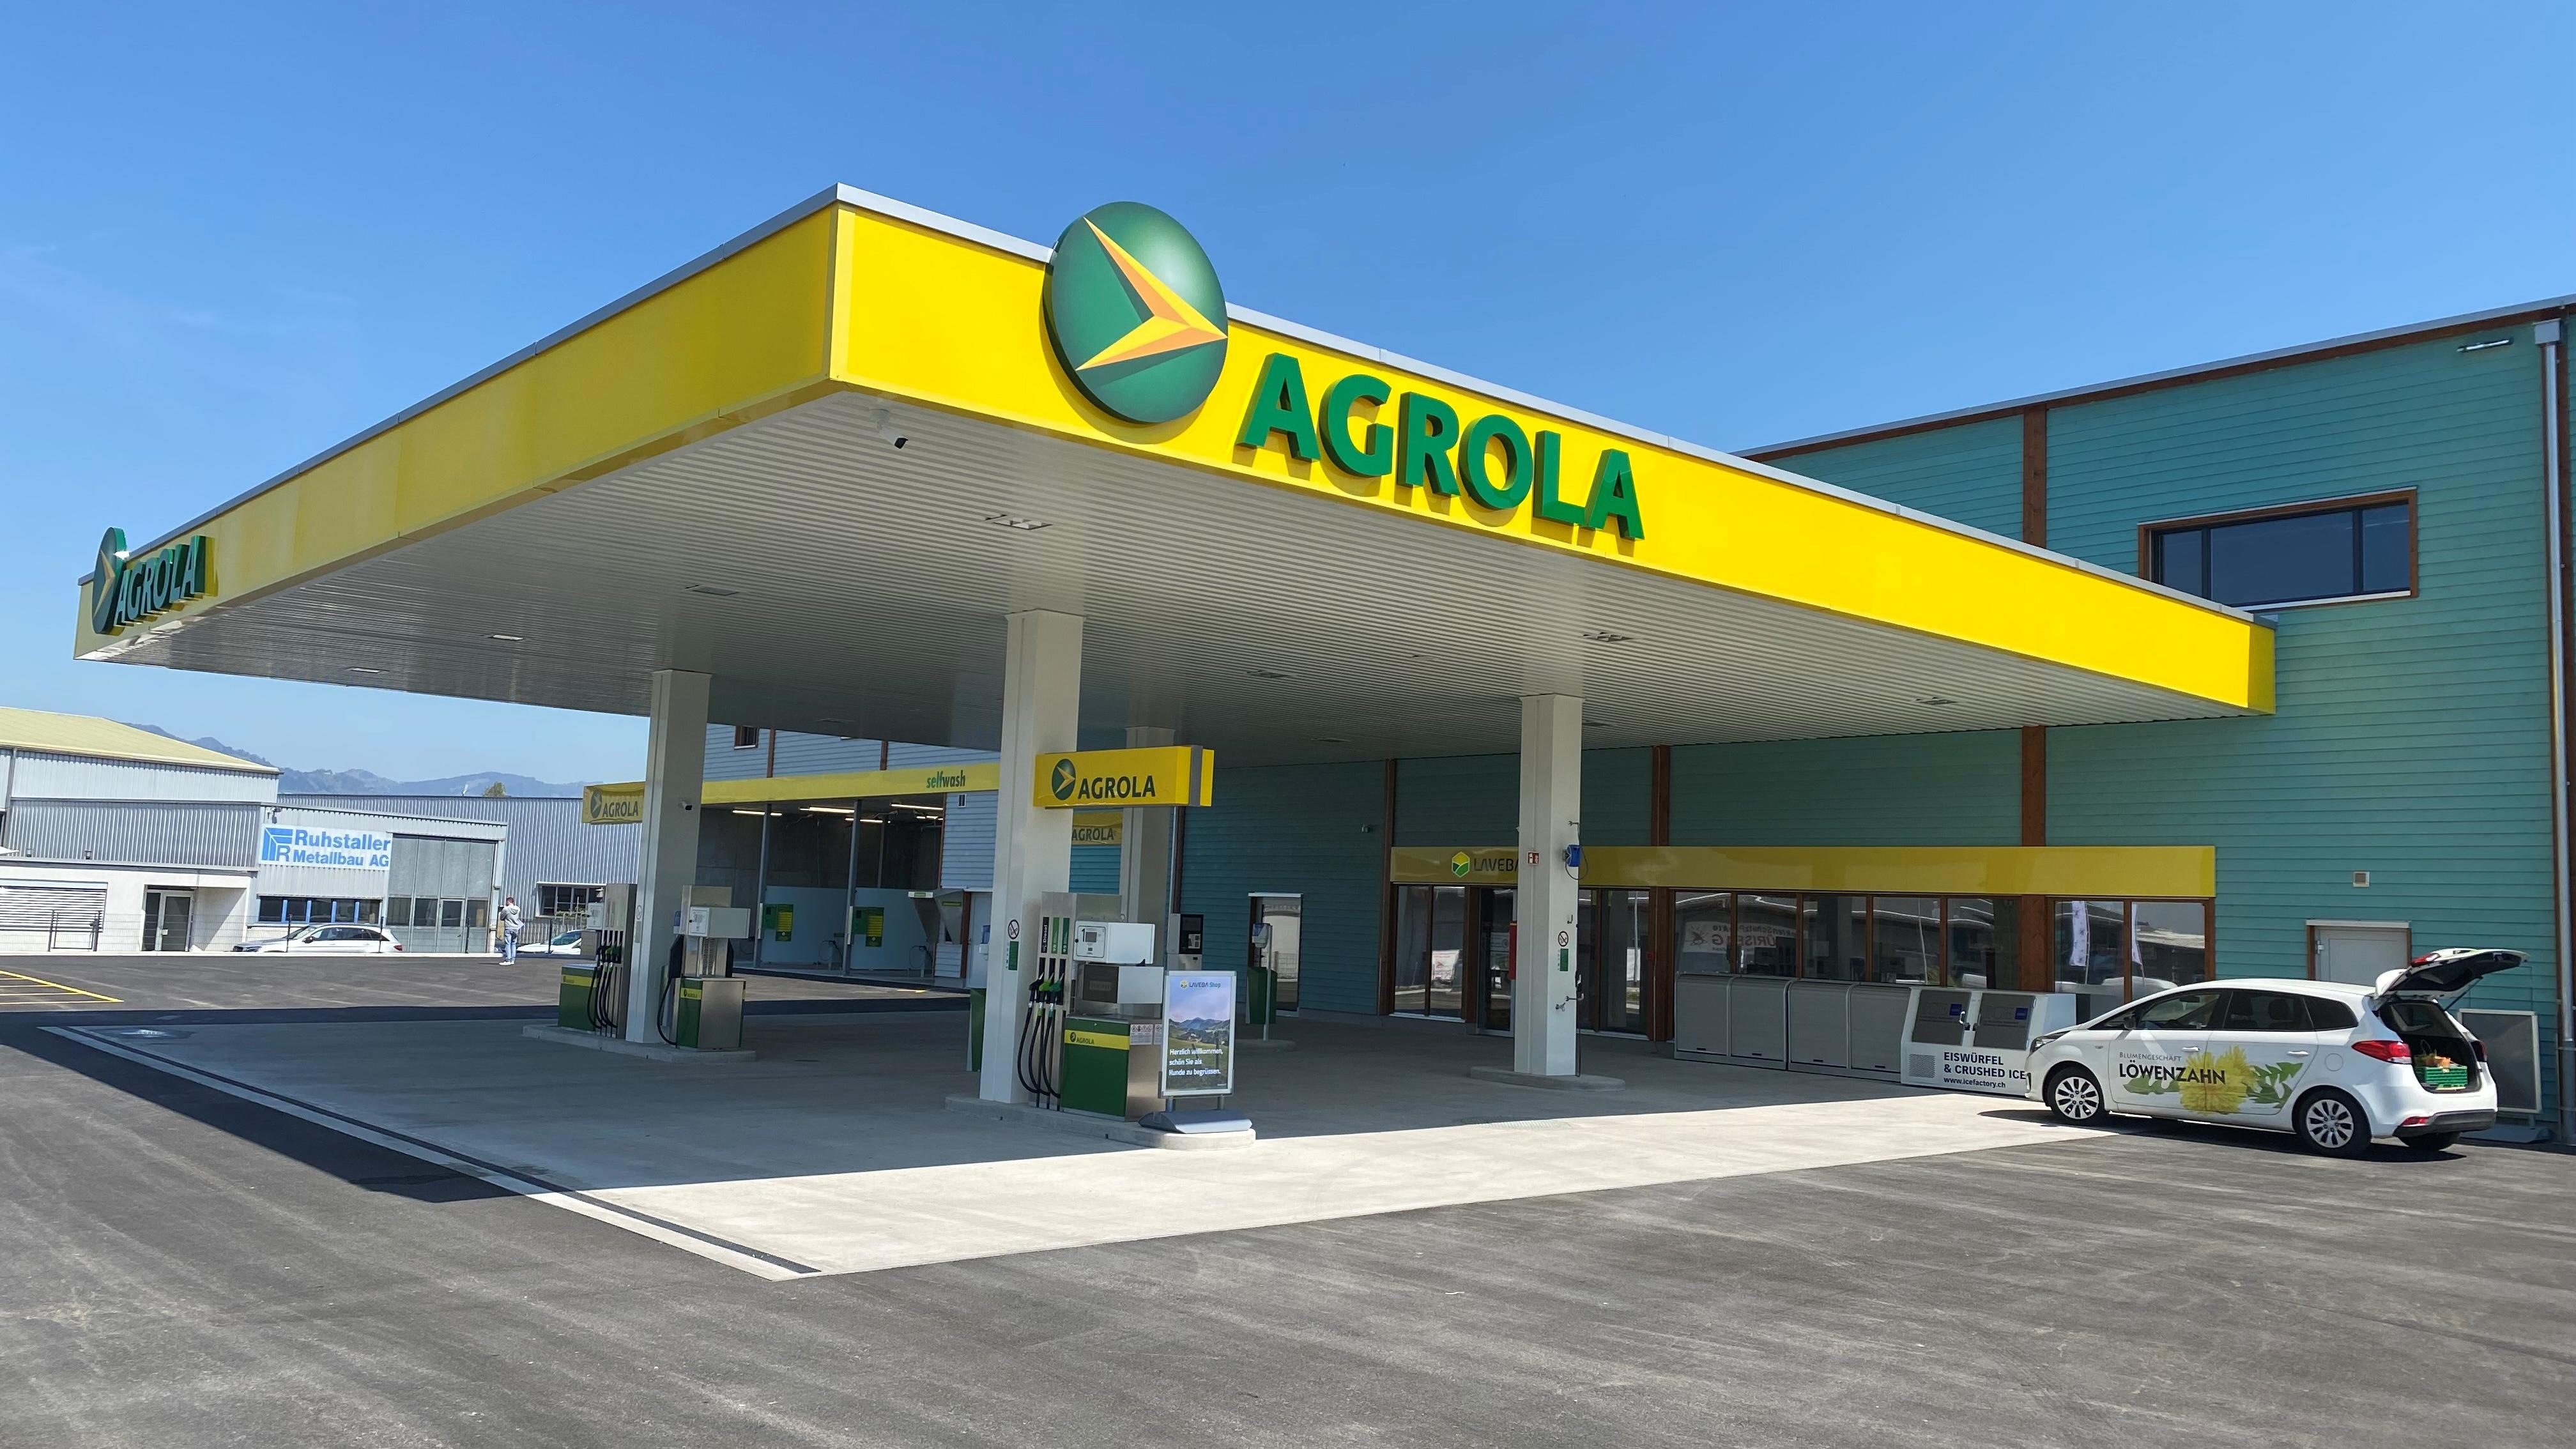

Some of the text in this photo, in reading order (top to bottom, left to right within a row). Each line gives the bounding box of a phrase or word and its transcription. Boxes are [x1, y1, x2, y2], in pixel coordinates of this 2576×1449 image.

[1235, 352, 1645, 540] AGROLA
[113, 535, 206, 627] AGROLA
[926, 769, 965, 788] selfwash
[1078, 775, 1156, 799] AGROLA
[602, 801, 638, 817] AGROLA
[295, 829, 391, 851] Ruhstaller
[1071, 827, 1114, 841] AGROLA
[293, 849, 389, 867] Metallbau AG
[1082, 928, 1085, 942] 1
[1943, 1052, 2004, 1066] EISWÜRFEL
[1943, 1064, 2027, 1080] & CRUSHED ICE
[2119, 1059, 2226, 1085] LÖWENZAHN
[1943, 1077, 2006, 1089] www.icefactory.ch
